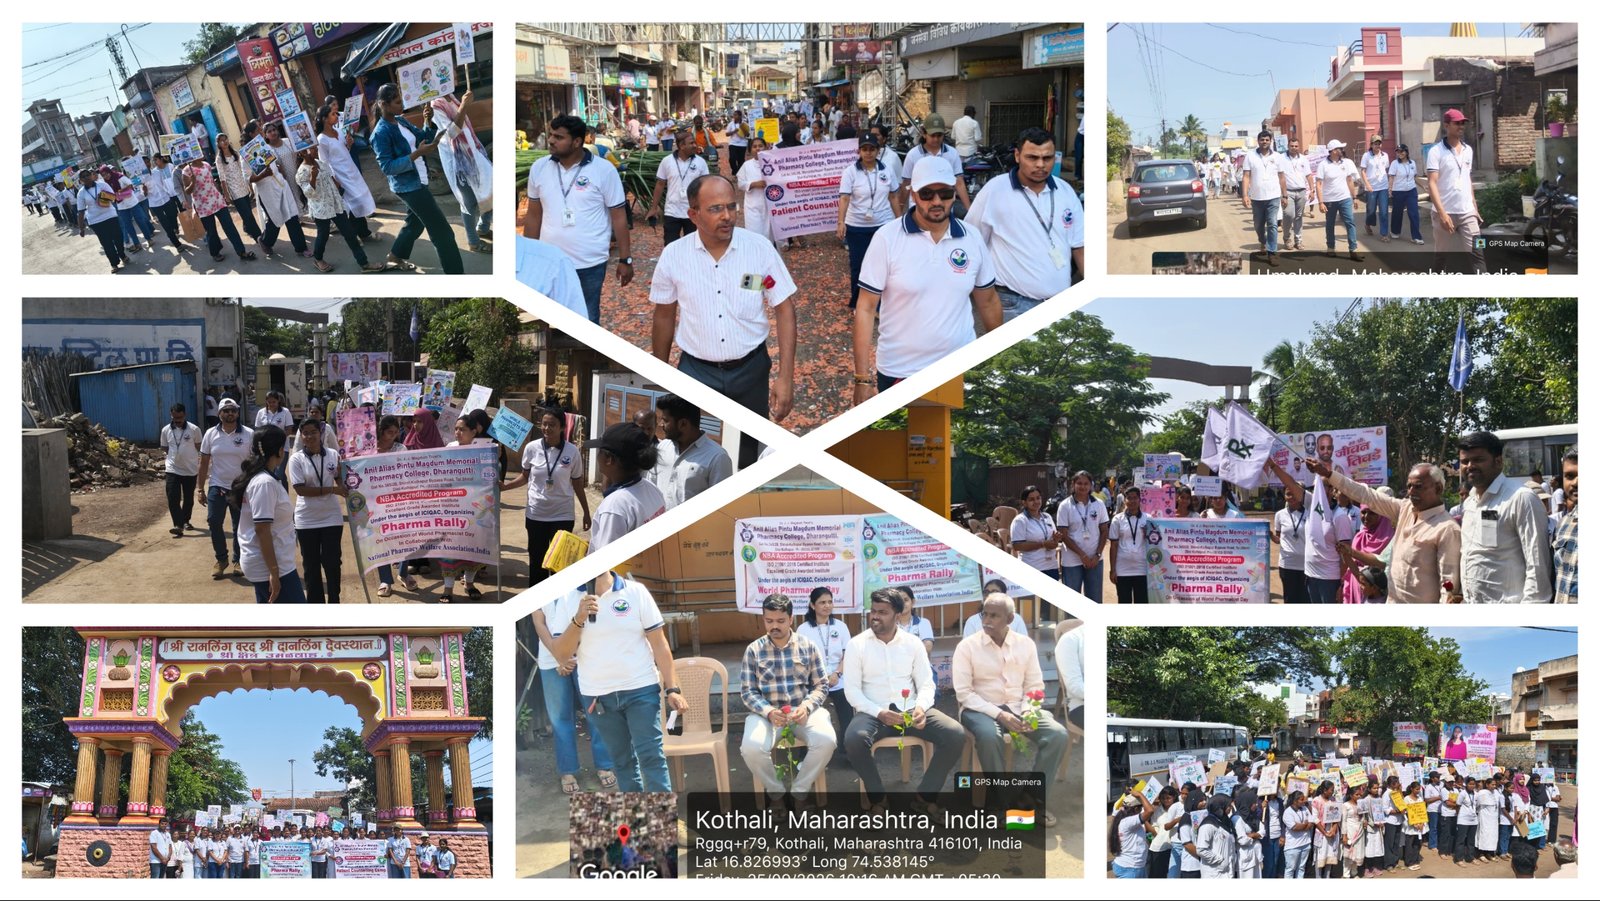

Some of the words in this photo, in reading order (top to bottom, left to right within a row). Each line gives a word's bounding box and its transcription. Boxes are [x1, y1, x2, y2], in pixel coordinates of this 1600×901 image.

[772, 206, 801, 216] Patient
[803, 201, 840, 211] Counsell
[1335, 440, 1371, 457] जीवन
[364, 466, 377, 474] Anil
[379, 464, 395, 472] Alias
[416, 459, 445, 469] Magdum
[369, 472, 403, 482] Pharmacy
[404, 469, 432, 477] College,
[379, 495, 395, 503] NBA
[397, 490, 432, 500] Accredited
[433, 489, 464, 498] Program
[370, 516, 387, 524] Under
[381, 520, 431, 534] Pharma
[434, 518, 467, 528] Rally
[368, 551, 390, 560] National
[391, 546, 418, 554] Pharmacy
[888, 573, 926, 582] Pharma
[929, 569, 954, 578] Rally
[758, 586, 778, 594] World
[781, 586, 814, 594] Pharmac
[1171, 584, 1213, 593] Pharma
[1216, 584, 1242, 594] Rally
[171, 640, 183, 651] श्री
[187, 640, 232, 652] रामलिंग
[236, 641, 256, 652] वरद
[260, 639, 274, 652] श्री
[277, 638, 322, 652] दानलिंग
[326, 638, 373, 651] देवस्थान
